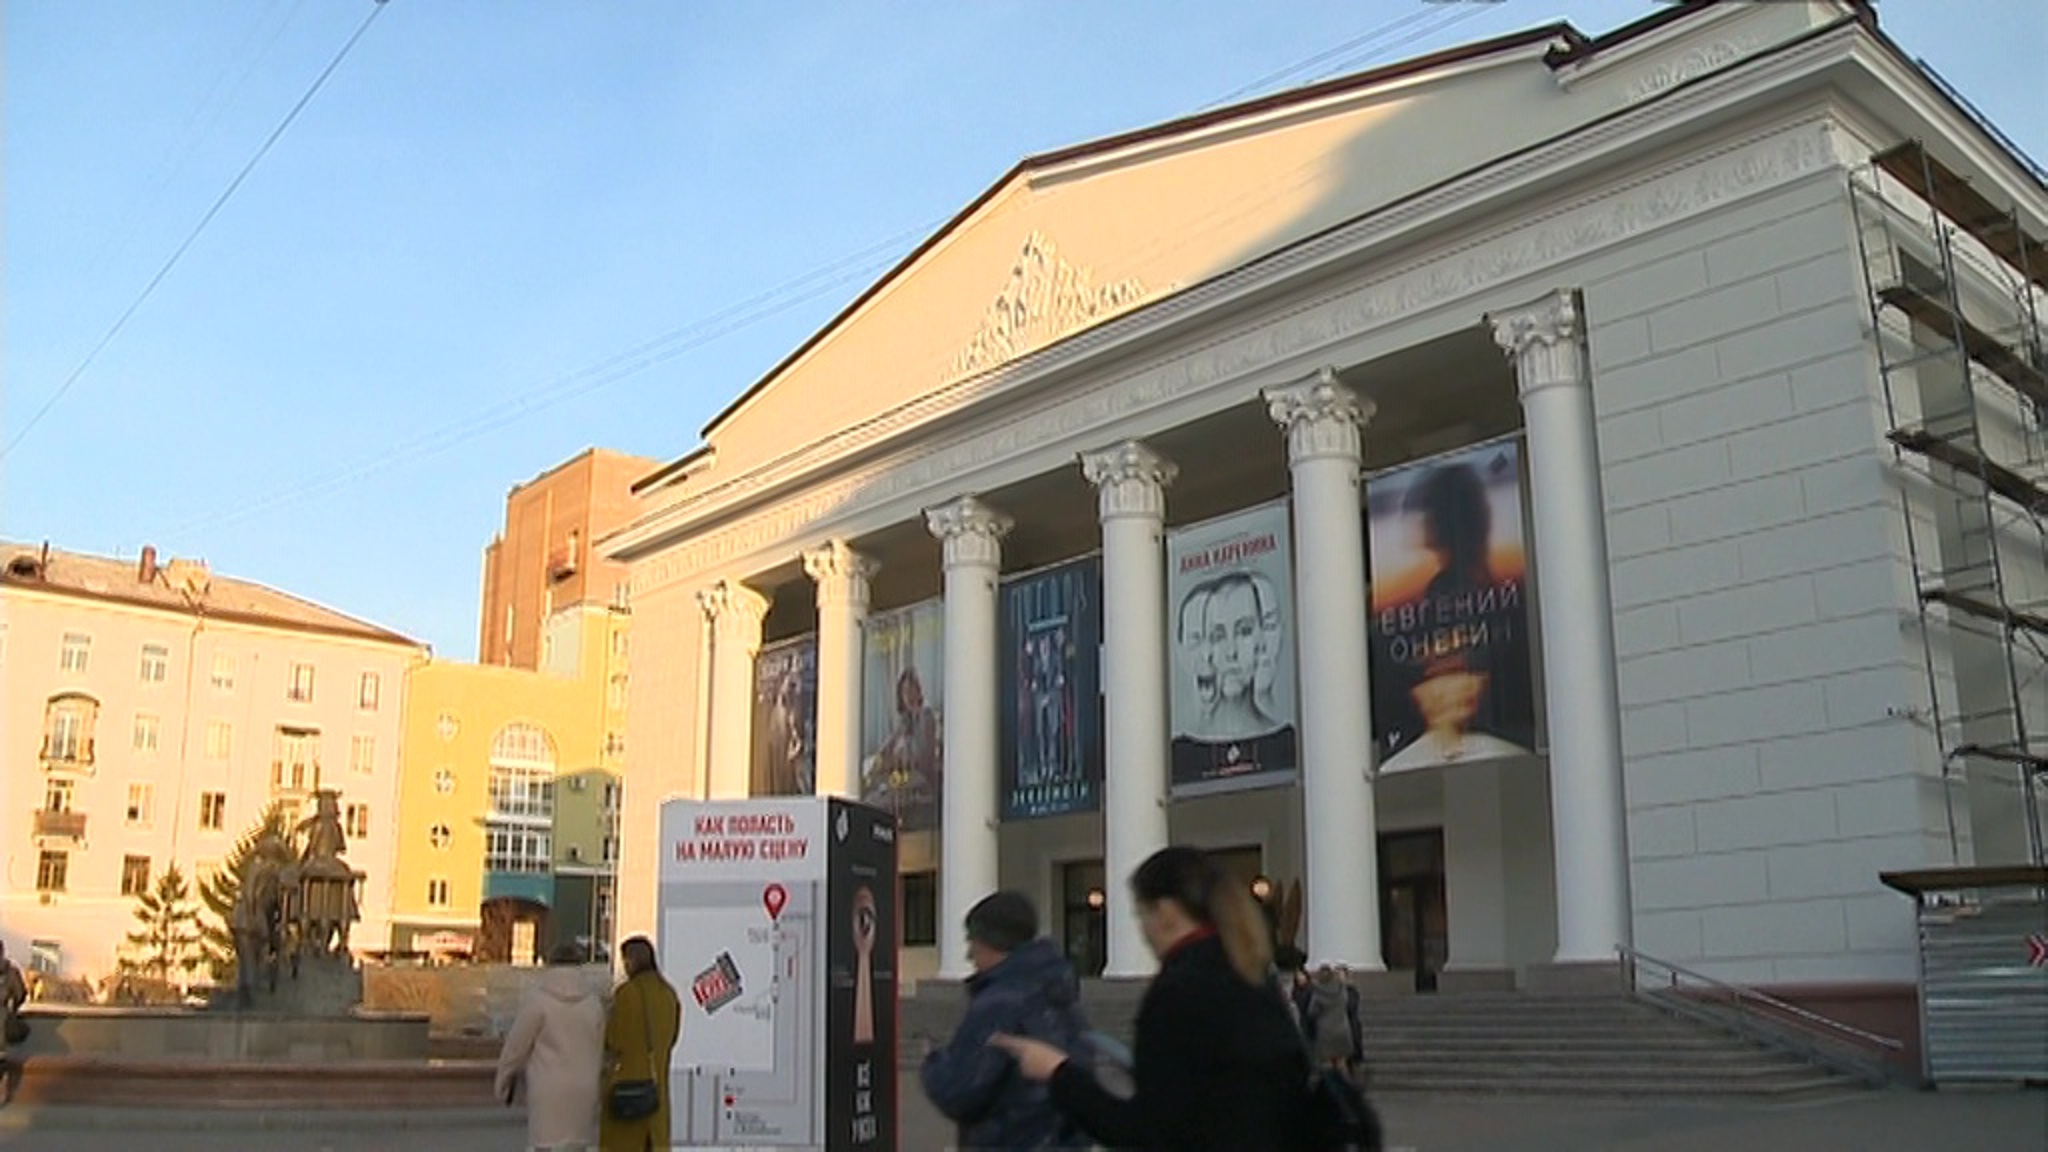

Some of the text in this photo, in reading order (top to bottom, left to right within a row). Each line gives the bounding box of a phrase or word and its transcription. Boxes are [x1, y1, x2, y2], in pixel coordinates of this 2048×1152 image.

[1381, 578, 1519, 636] ЕВГЕНИЙ
[694, 812, 796, 834] КАК ПОПАСТЬ
[676, 837, 808, 862] НА МАЛУЮ СЦЕНУ
